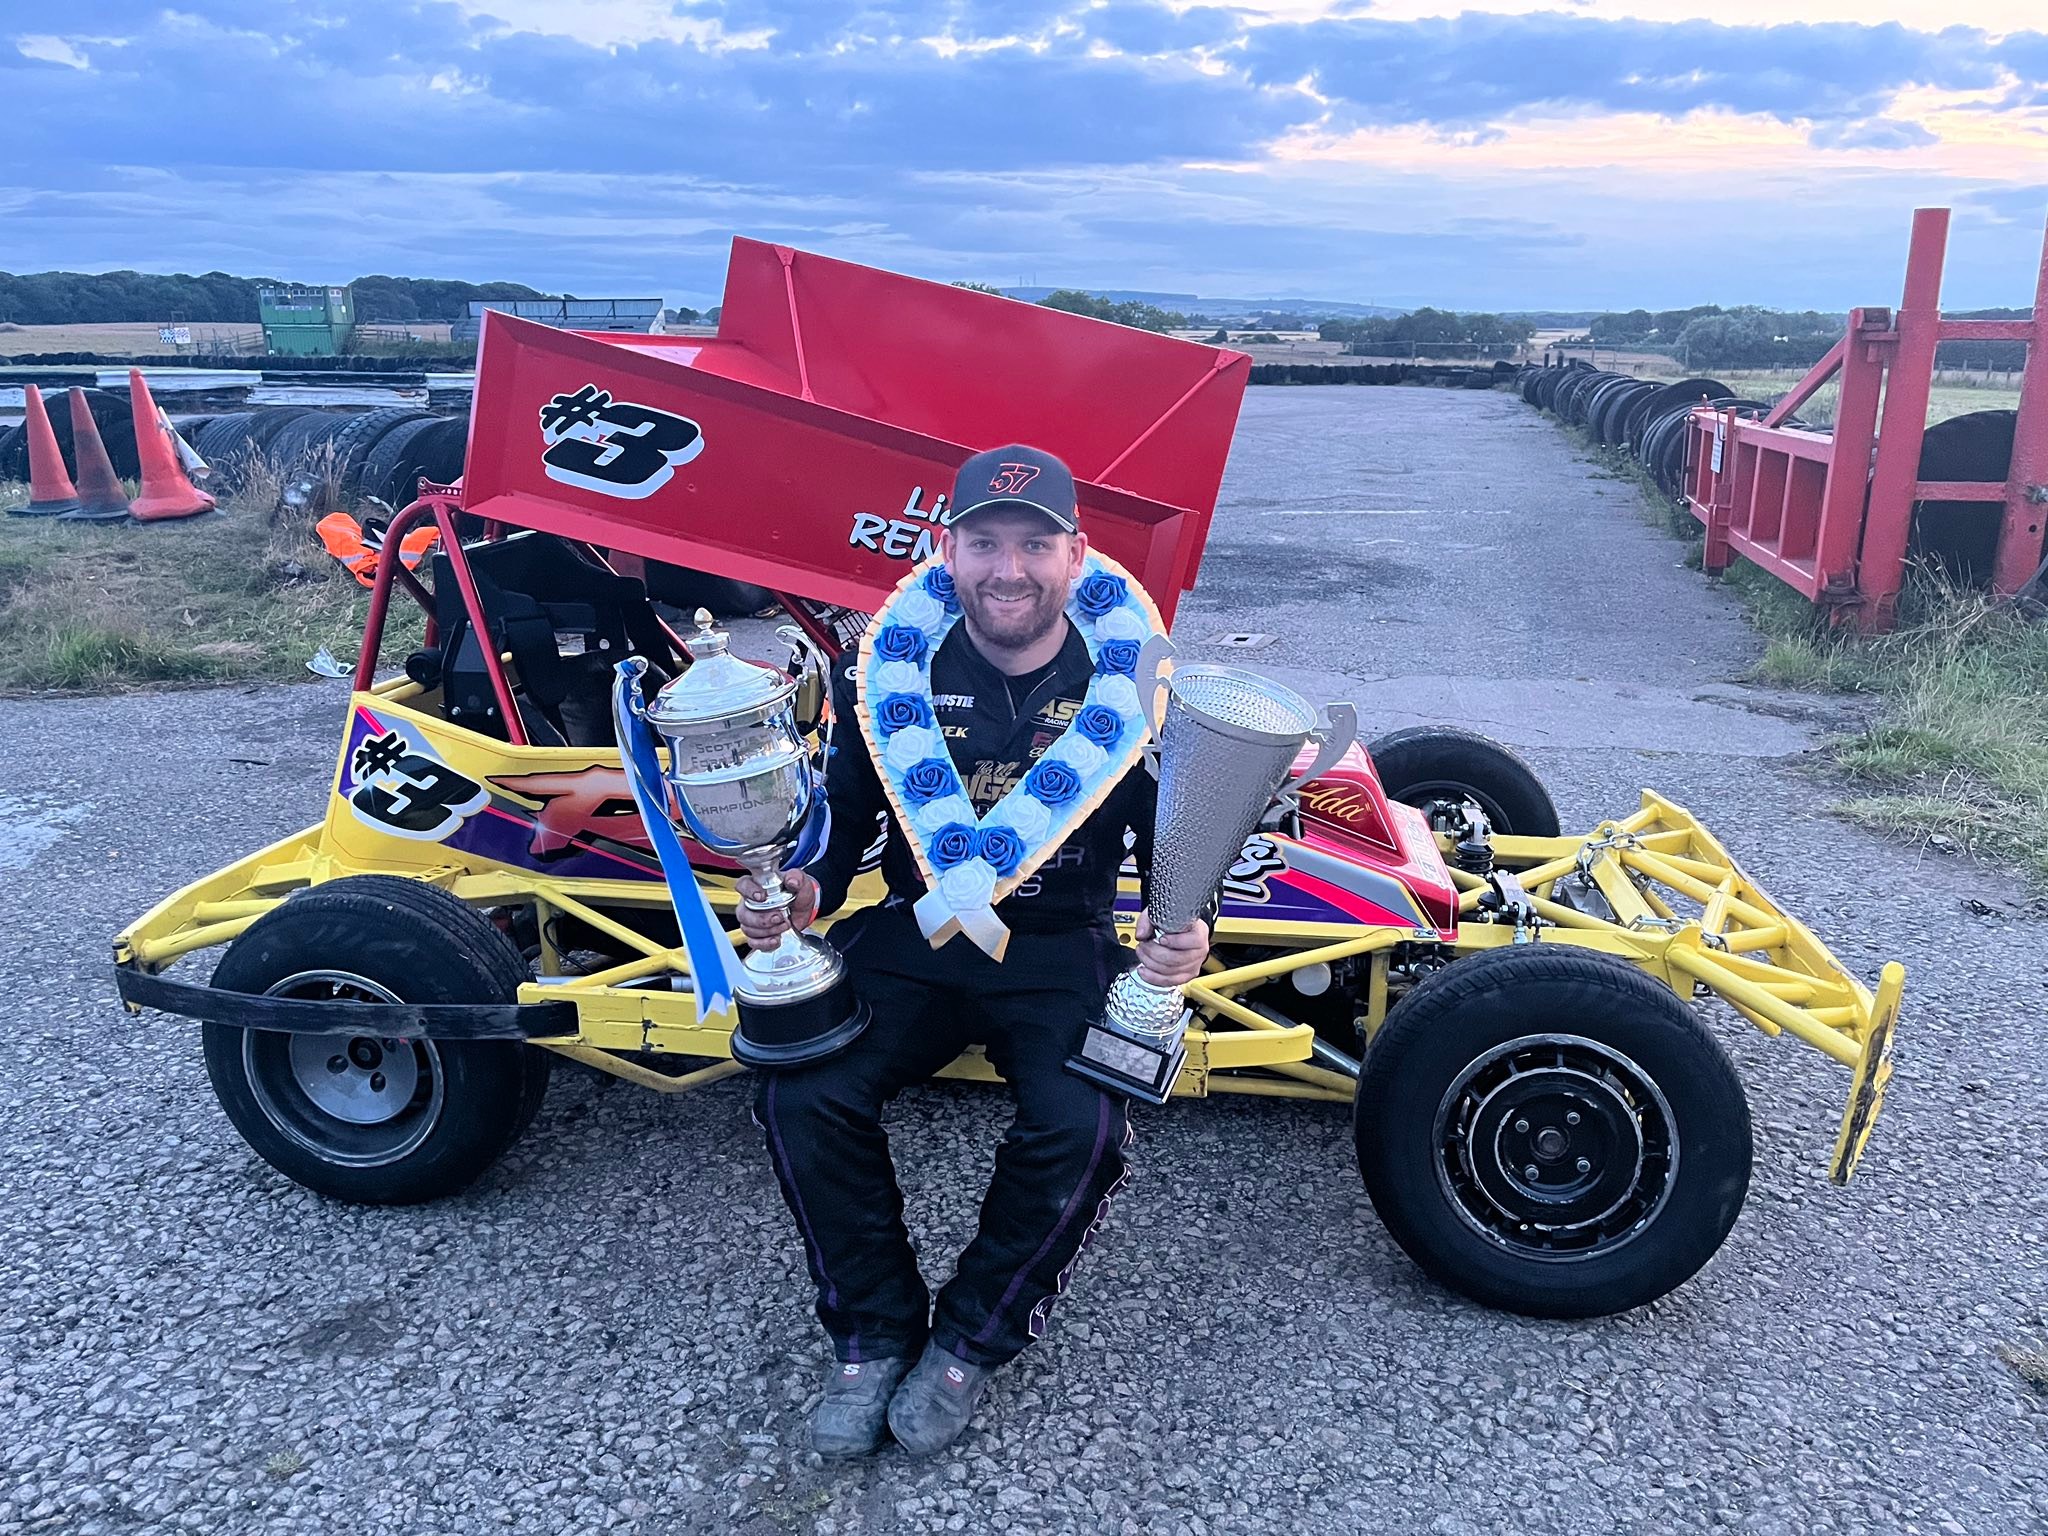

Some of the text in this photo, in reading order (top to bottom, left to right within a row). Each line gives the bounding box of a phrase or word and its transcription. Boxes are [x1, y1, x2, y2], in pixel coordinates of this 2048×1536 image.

[540, 383, 704, 499] #3
[986, 463, 1040, 494] 57
[850, 513, 944, 561] REN
[932, 693, 975, 708] OUSTIE
[1037, 698, 1081, 721] AS
[349, 729, 491, 842] #3
